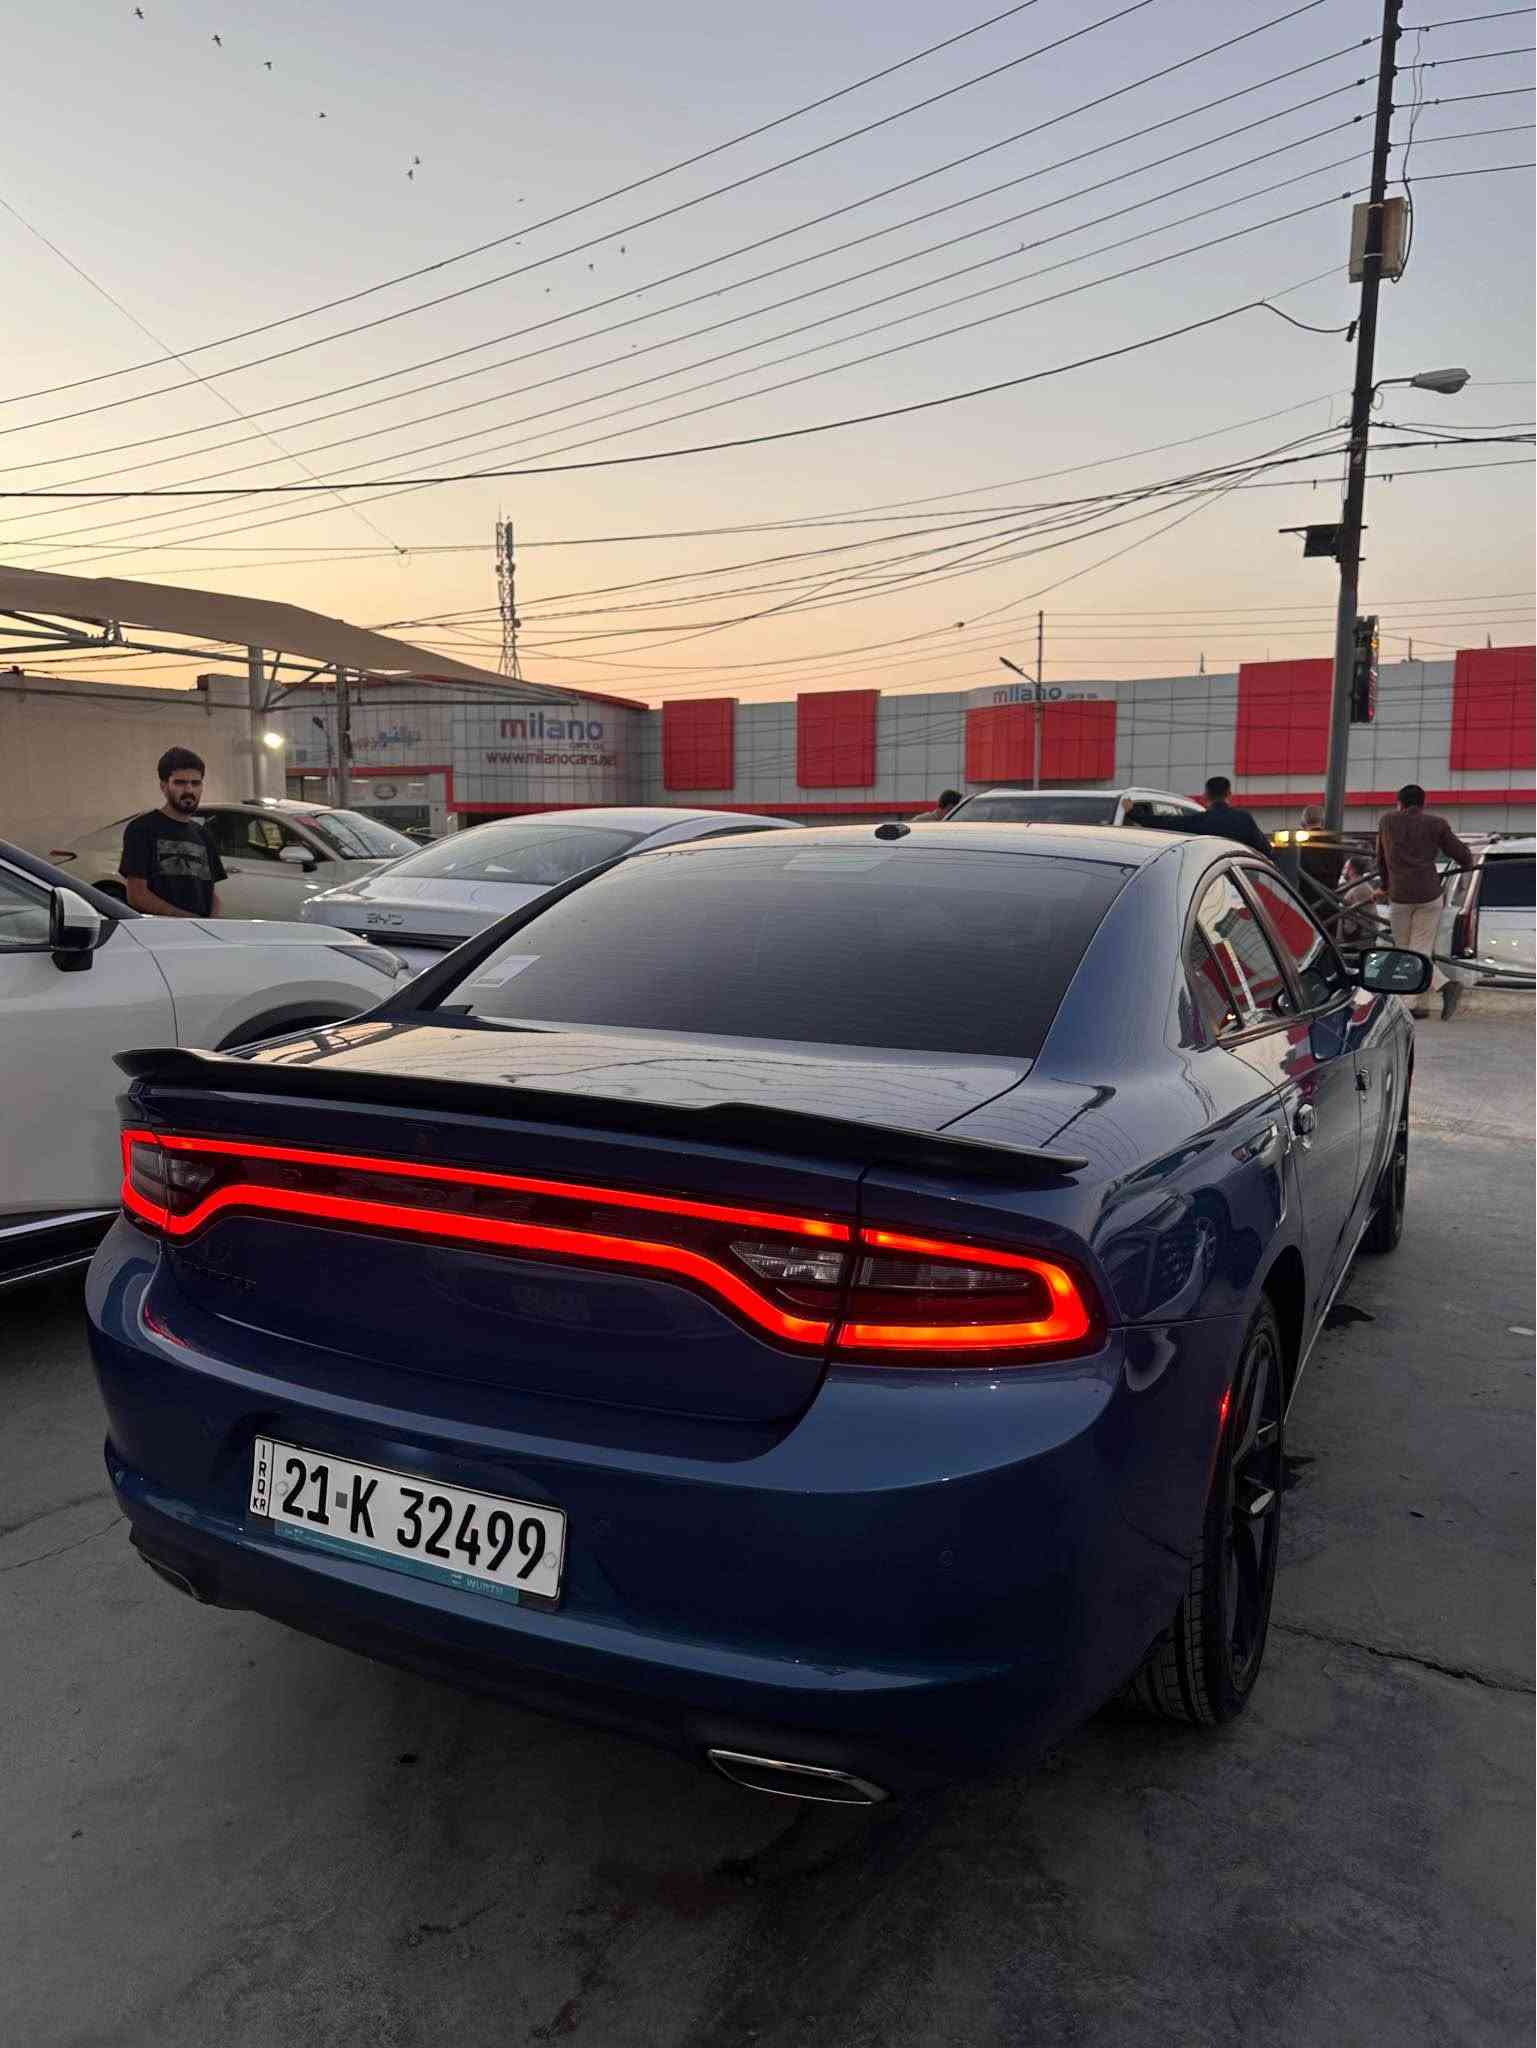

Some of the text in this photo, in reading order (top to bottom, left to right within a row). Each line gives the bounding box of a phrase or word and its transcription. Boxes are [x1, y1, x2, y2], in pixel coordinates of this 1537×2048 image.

[501, 711, 604, 740] milano
[366, 912, 405, 926] BYD
[397, 1486, 546, 1580] 32499
